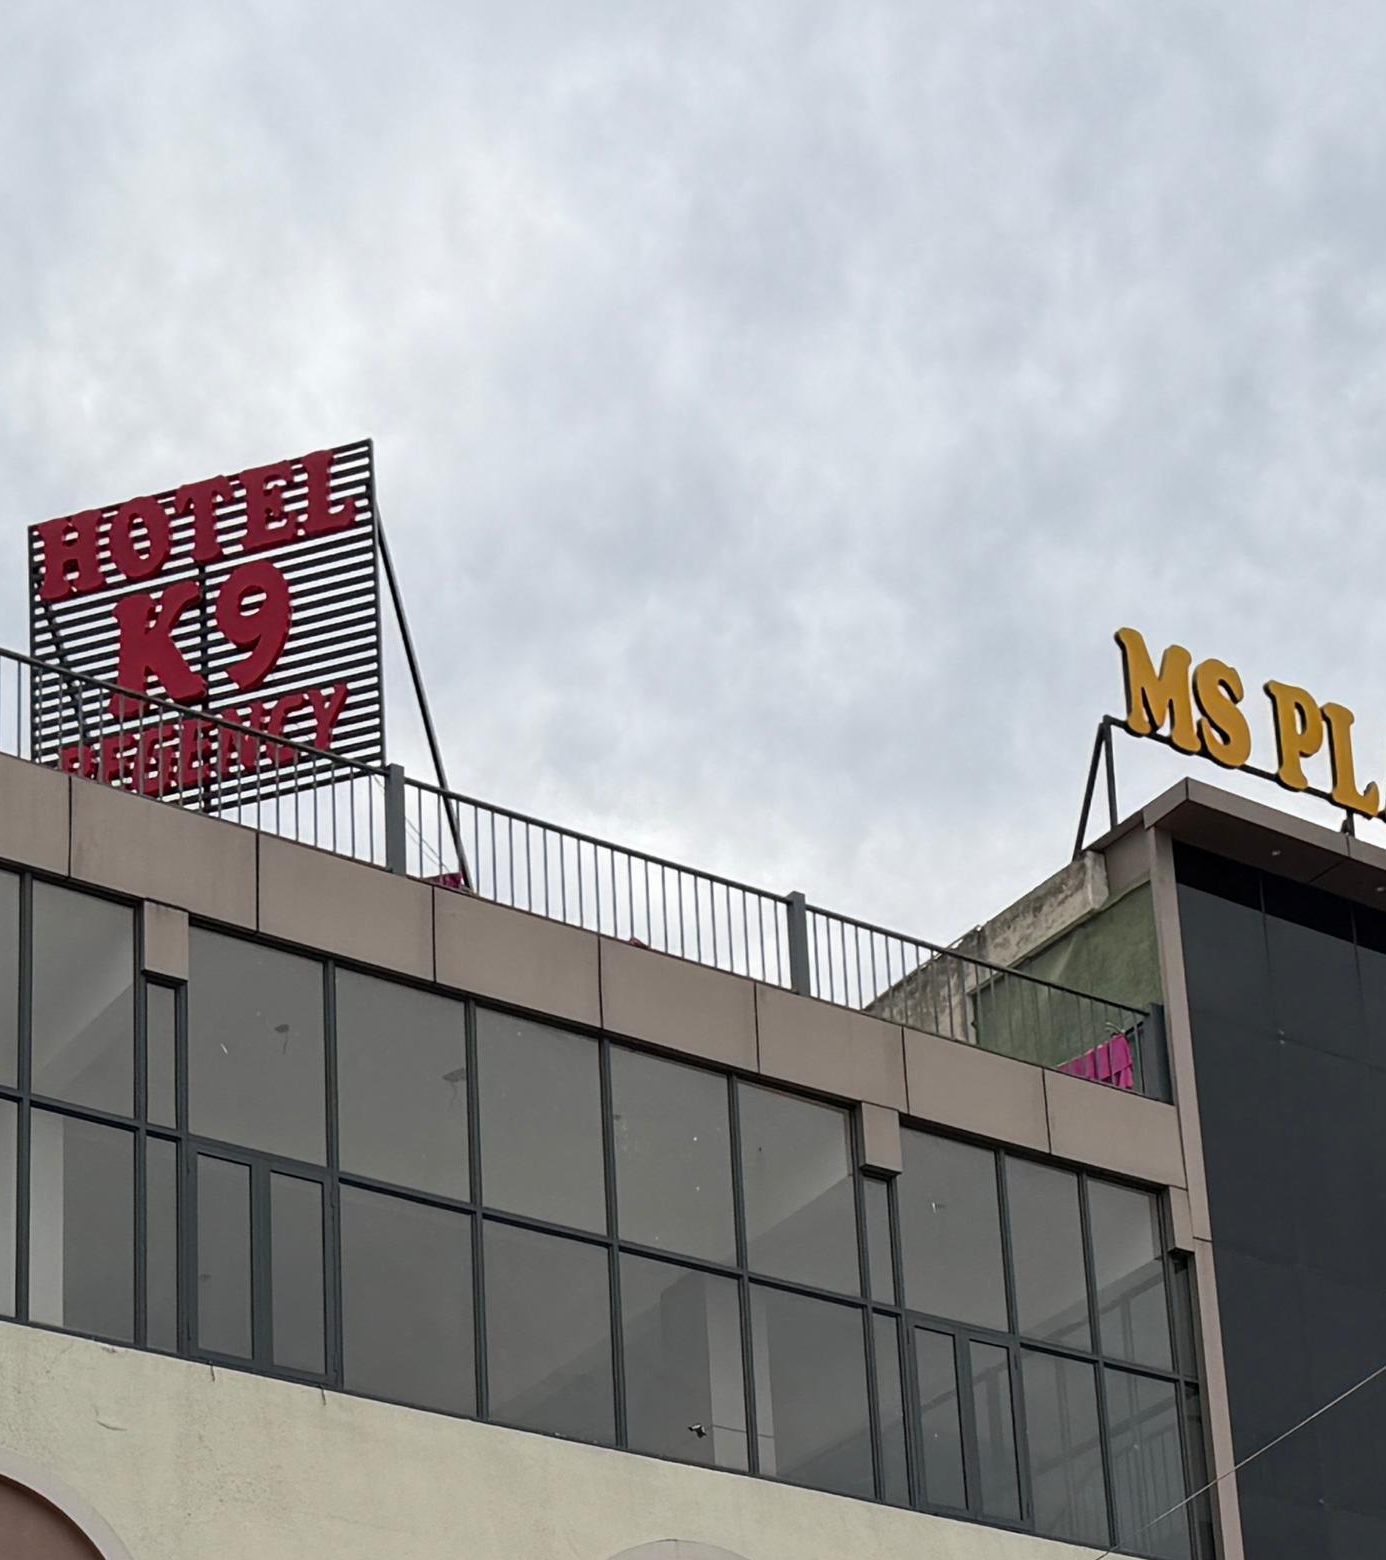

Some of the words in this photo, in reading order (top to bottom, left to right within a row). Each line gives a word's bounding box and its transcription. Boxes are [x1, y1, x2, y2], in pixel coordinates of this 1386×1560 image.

[37, 449, 357, 601] HOTEL
[108, 559, 293, 719] K9
[1114, 626, 1252, 770] MS
